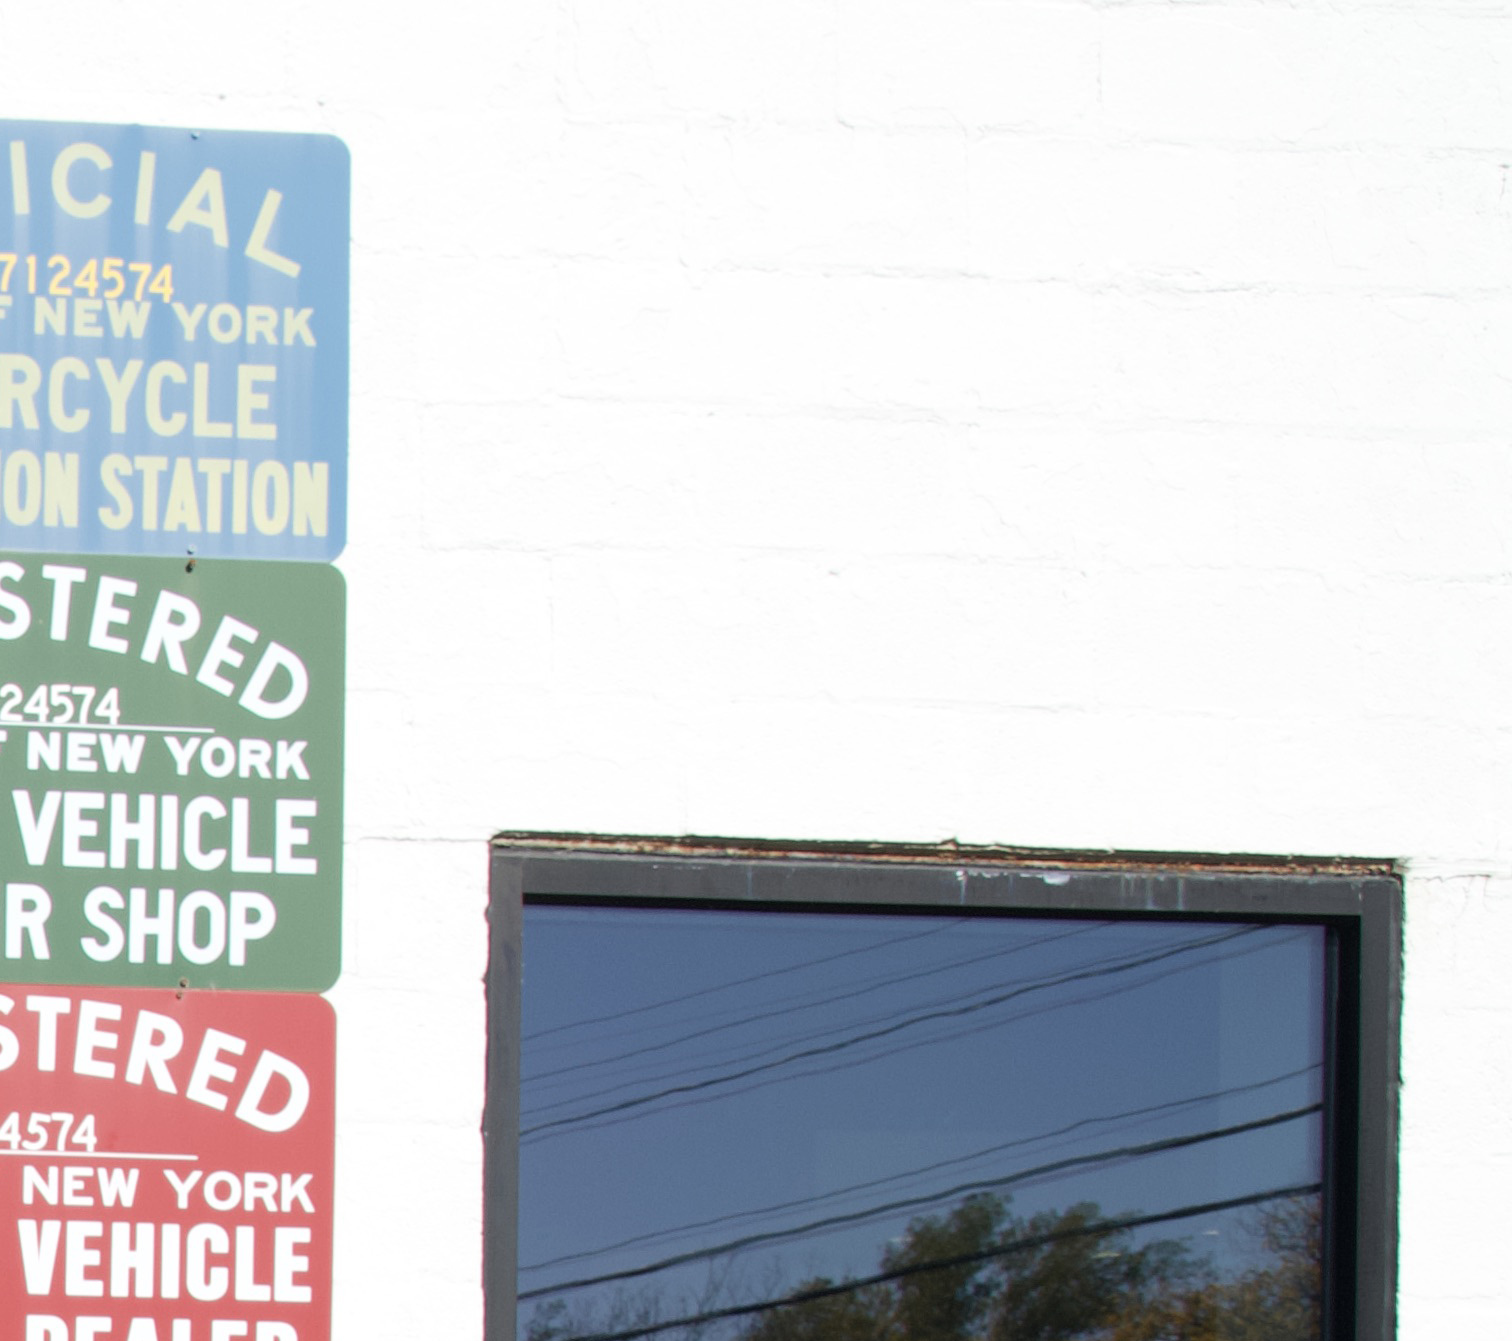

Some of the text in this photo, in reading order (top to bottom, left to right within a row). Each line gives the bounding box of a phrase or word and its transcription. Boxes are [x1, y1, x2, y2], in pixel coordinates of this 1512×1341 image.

[33, 297, 150, 339] NEW
[170, 301, 316, 347] YORK
[98, 453, 328, 536] STATION
[27, 730, 145, 774] NEW
[164, 736, 310, 780] YORK
[12, 789, 317, 875] VEHICLE
[80, 886, 276, 966] SHOP
[22, 1165, 139, 1208] NEW
[163, 1169, 315, 1213] YORK
[17, 1218, 312, 1303] VEHICLE
